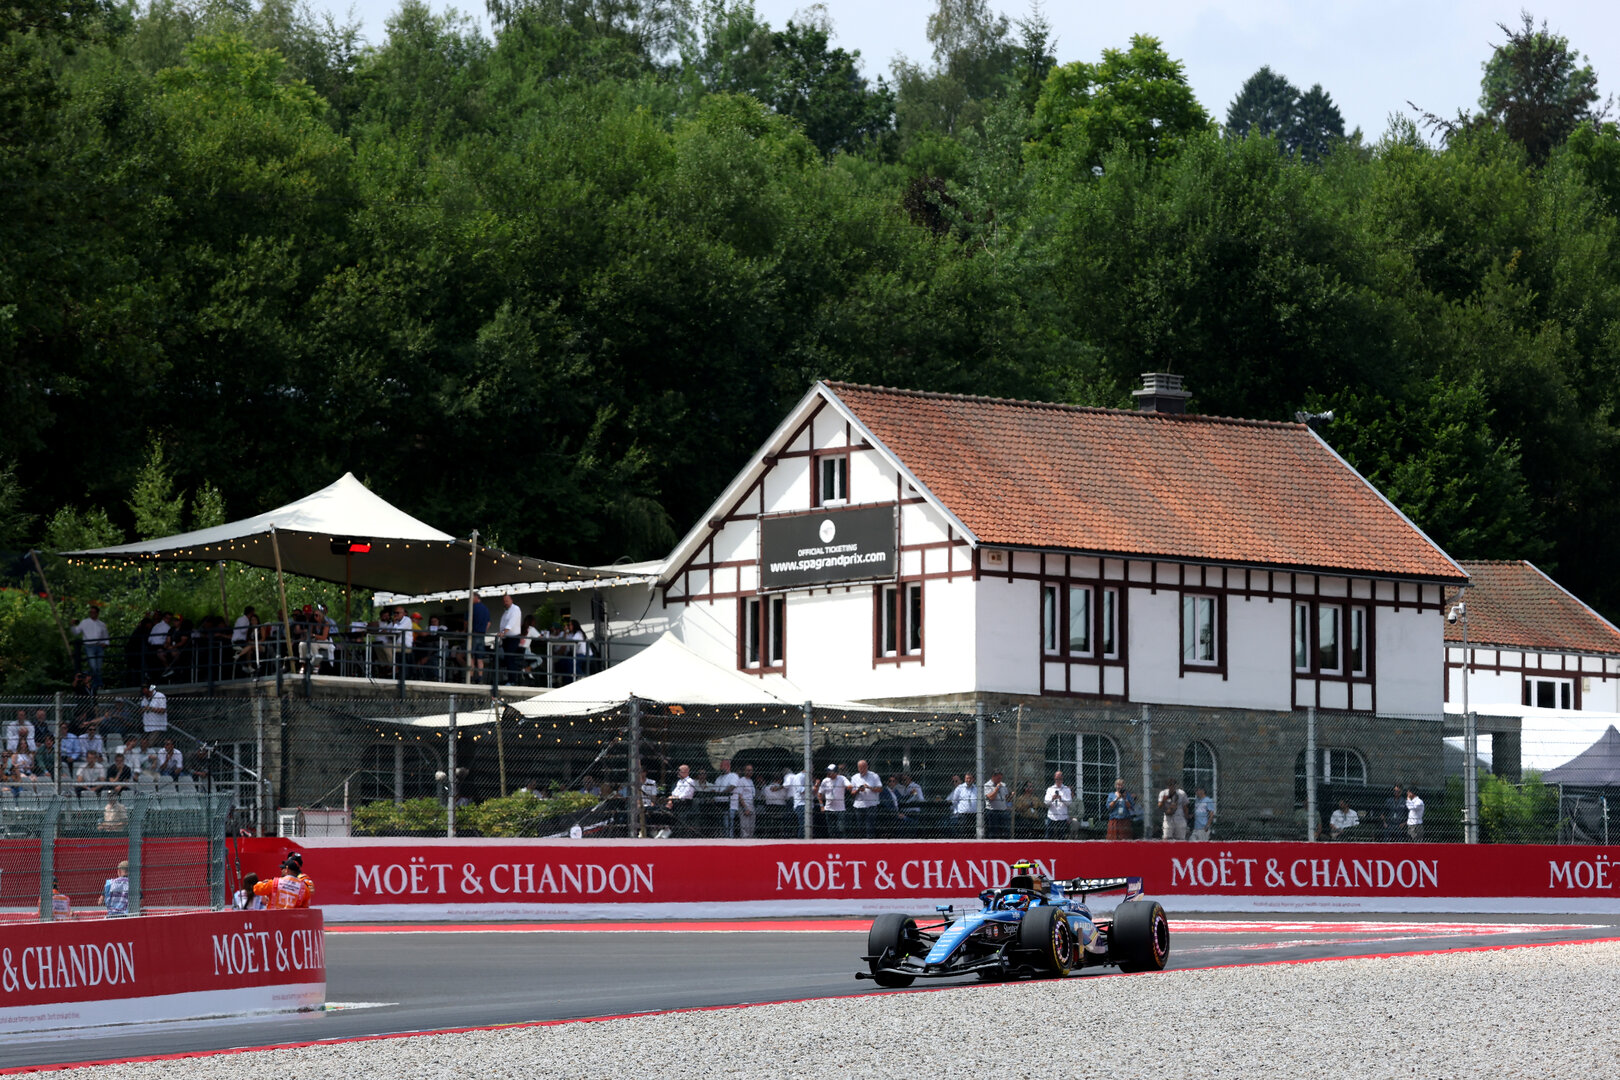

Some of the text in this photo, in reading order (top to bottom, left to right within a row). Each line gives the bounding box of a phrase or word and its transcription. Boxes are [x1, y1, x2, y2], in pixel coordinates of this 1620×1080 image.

[770, 552, 886, 572] www.spagrandprix.com
[797, 543, 858, 557] OFFICIAL TICKETING
[353, 856, 655, 895] MOËT & CHANDON
[776, 853, 867, 891] MOËT
[874, 860, 896, 890] &
[1171, 850, 1439, 889] MOËT & CHANDON
[2, 941, 136, 993] & CHANDON
[212, 922, 270, 976] MOËT
[274, 929, 290, 972] &
